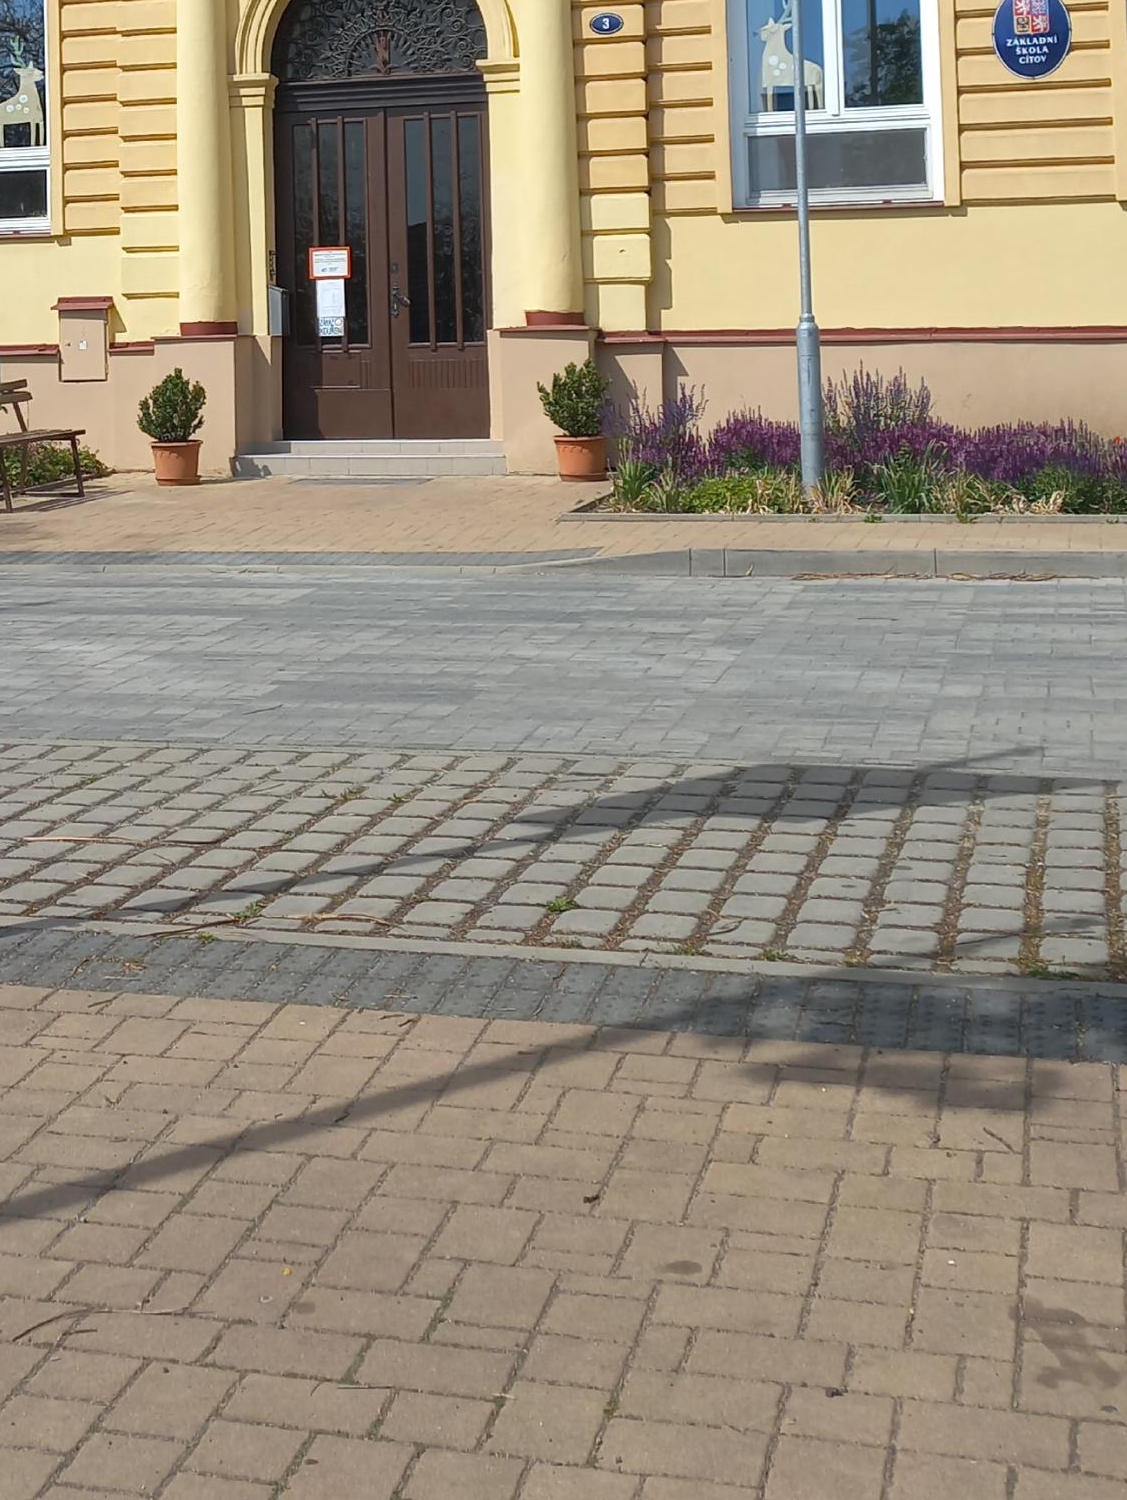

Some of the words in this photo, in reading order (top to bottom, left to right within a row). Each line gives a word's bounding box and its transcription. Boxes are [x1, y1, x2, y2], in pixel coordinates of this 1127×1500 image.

[602, 17, 610, 30] 3
[1006, 34, 1058, 47] ZÁKLADNÍ
[1016, 45, 1049, 55] ŠKOLA
[1019, 55, 1047, 64] CÍTOV
